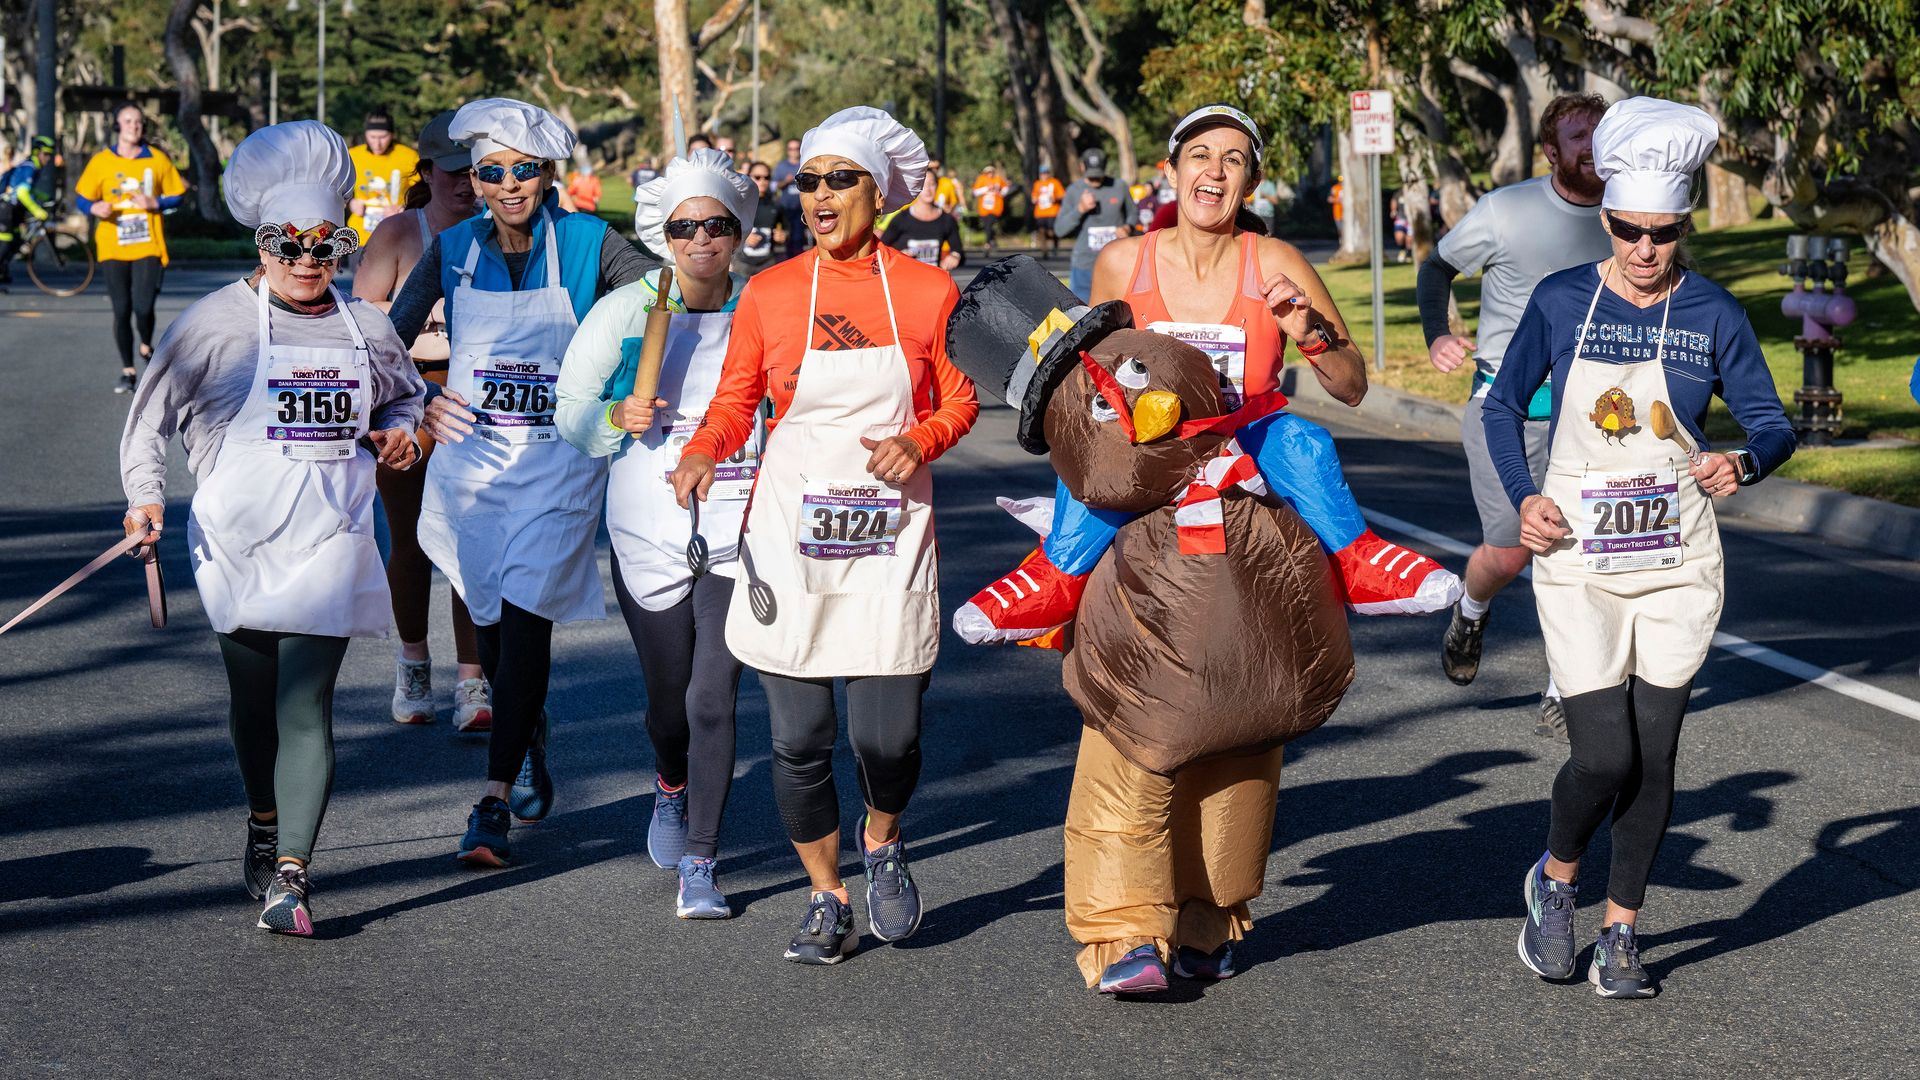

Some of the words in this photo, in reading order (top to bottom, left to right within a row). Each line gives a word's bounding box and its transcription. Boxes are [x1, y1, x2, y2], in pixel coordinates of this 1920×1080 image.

[1354, 96, 1370, 108] NO
[1353, 112, 1393, 125] STOPPING
[1365, 127, 1381, 135] ANY
[1364, 137, 1382, 146] TIME
[837, 320, 870, 349] MCM
[1574, 322, 1597, 341] OC
[1600, 323, 1643, 343] CHILI
[1645, 325, 1710, 354] WINTER
[1574, 344, 1616, 355] RAIL
[1622, 347, 1651, 358] RUN
[1661, 349, 1709, 367] SERIES
[495, 364, 541, 373] TURKEYTROT
[292, 370, 340, 379] TURKEYTROT
[481, 380, 549, 413] 2376
[277, 390, 352, 424] 3159
[290, 430, 338, 438] TURKEYTROT.COM
[537, 432, 551, 440] 2376
[1605, 475, 1657, 488] TURKEYTROT
[827, 488, 880, 497] TURKEYTROT
[1593, 497, 1669, 536] 2072
[812, 507, 888, 542] 3124
[1607, 540, 1659, 550] TURKEYTROT.COM
[823, 547, 871, 555] TURKEYTROT.COM
[1661, 557, 1676, 565] 2072
